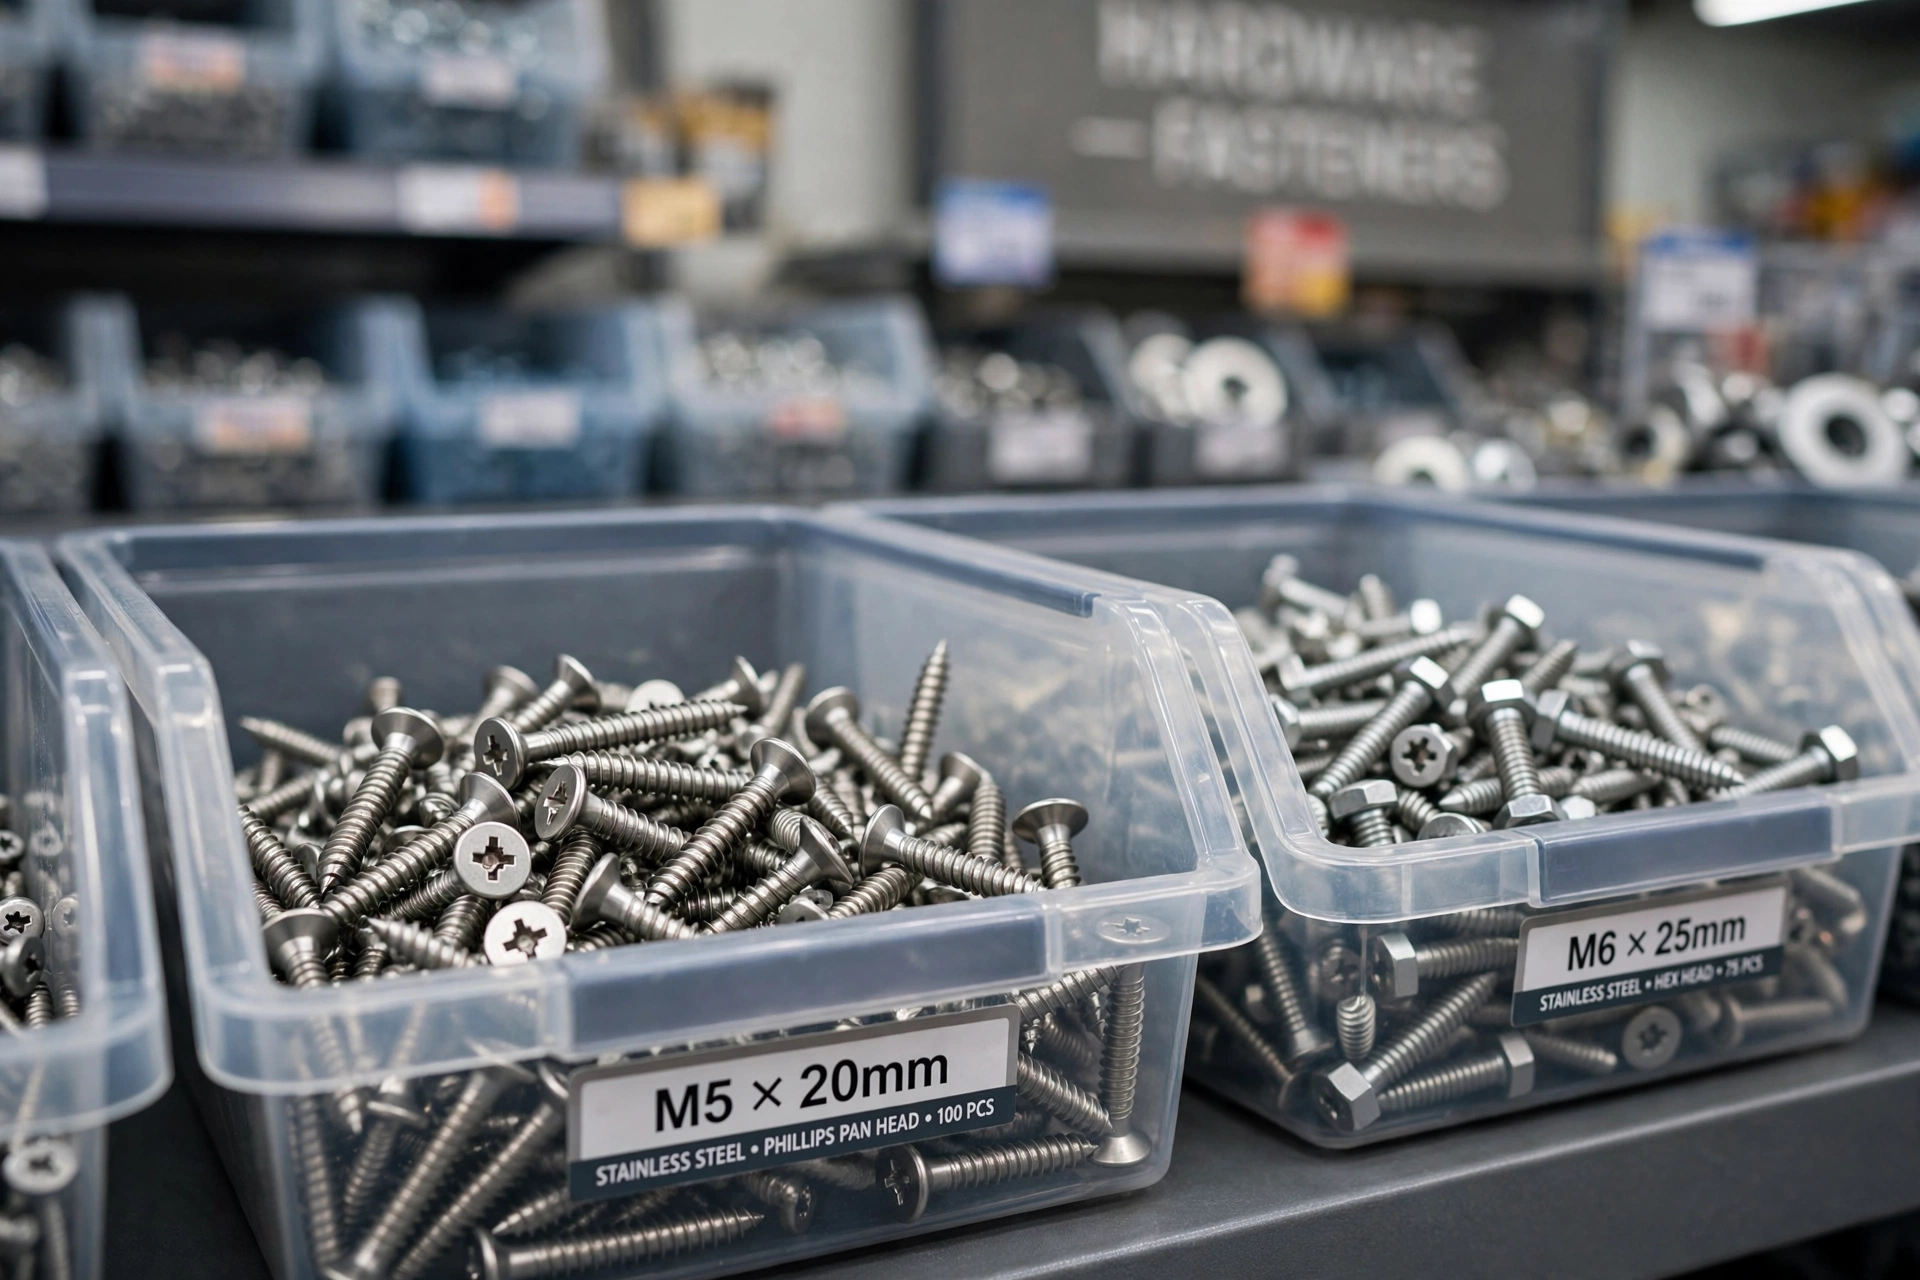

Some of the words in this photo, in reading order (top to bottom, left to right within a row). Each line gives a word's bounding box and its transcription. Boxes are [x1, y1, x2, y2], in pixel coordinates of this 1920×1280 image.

[1567, 931, 1616, 971] M6
[1655, 916, 1746, 956] 25mm
[1539, 984, 1605, 1012] STAINLESS
[1606, 976, 1642, 997] STEEL
[1654, 970, 1679, 990] HEX
[1680, 963, 1714, 985] HEAD
[1741, 954, 1764, 974] PCS
[655, 1079, 733, 1132] M5
[799, 1053, 949, 1108] 20mm
[595, 1151, 691, 1187] STAINLESS
[695, 1142, 746, 1169] STEEL
[764, 1126, 835, 1156] PHILLIPS
[839, 1120, 872, 1143] PAN
[876, 1112, 920, 1136] HEAD
[937, 1104, 963, 1124] 100
[966, 1098, 995, 1119] PCS
